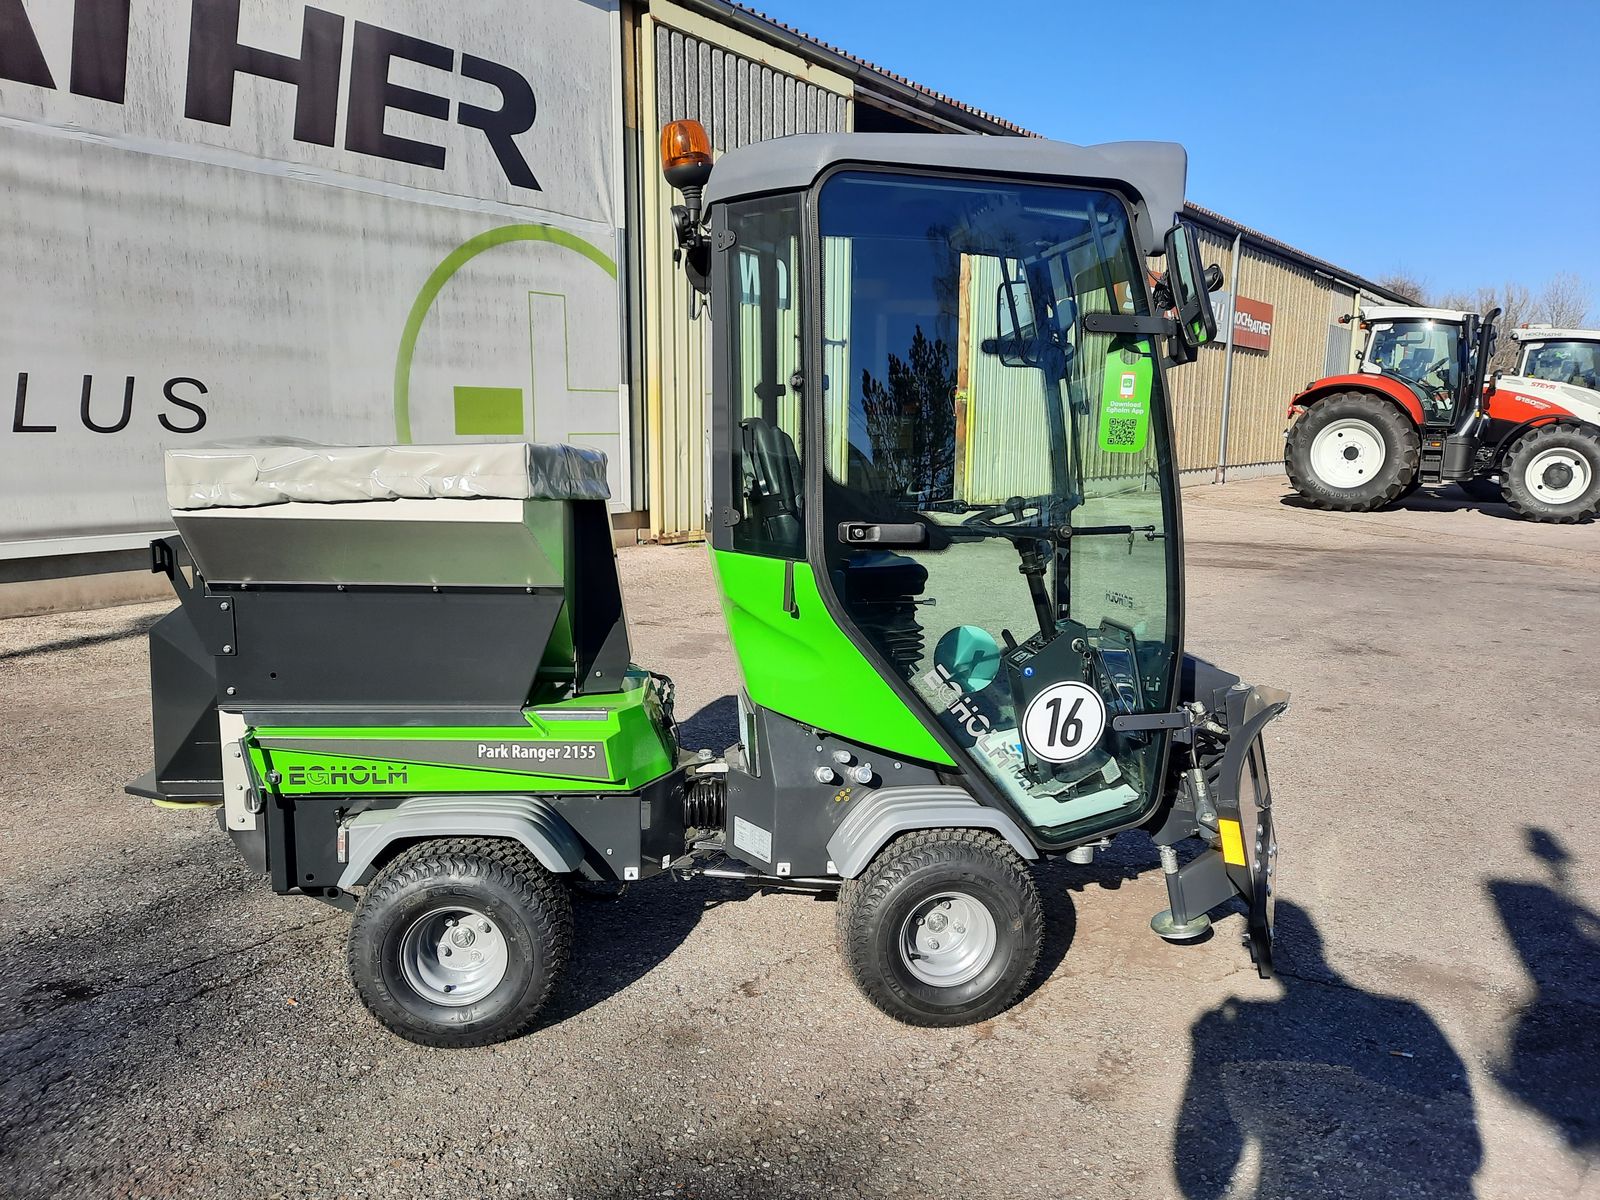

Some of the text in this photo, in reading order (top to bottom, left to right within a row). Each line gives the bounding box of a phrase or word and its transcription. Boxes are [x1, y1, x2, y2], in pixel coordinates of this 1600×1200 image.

[1530, 381, 1557, 391] STEYR
[1046, 698, 1084, 747] 16
[478, 744, 596, 762] Park Ranger 2155
[289, 766, 408, 785] EGHOLM
